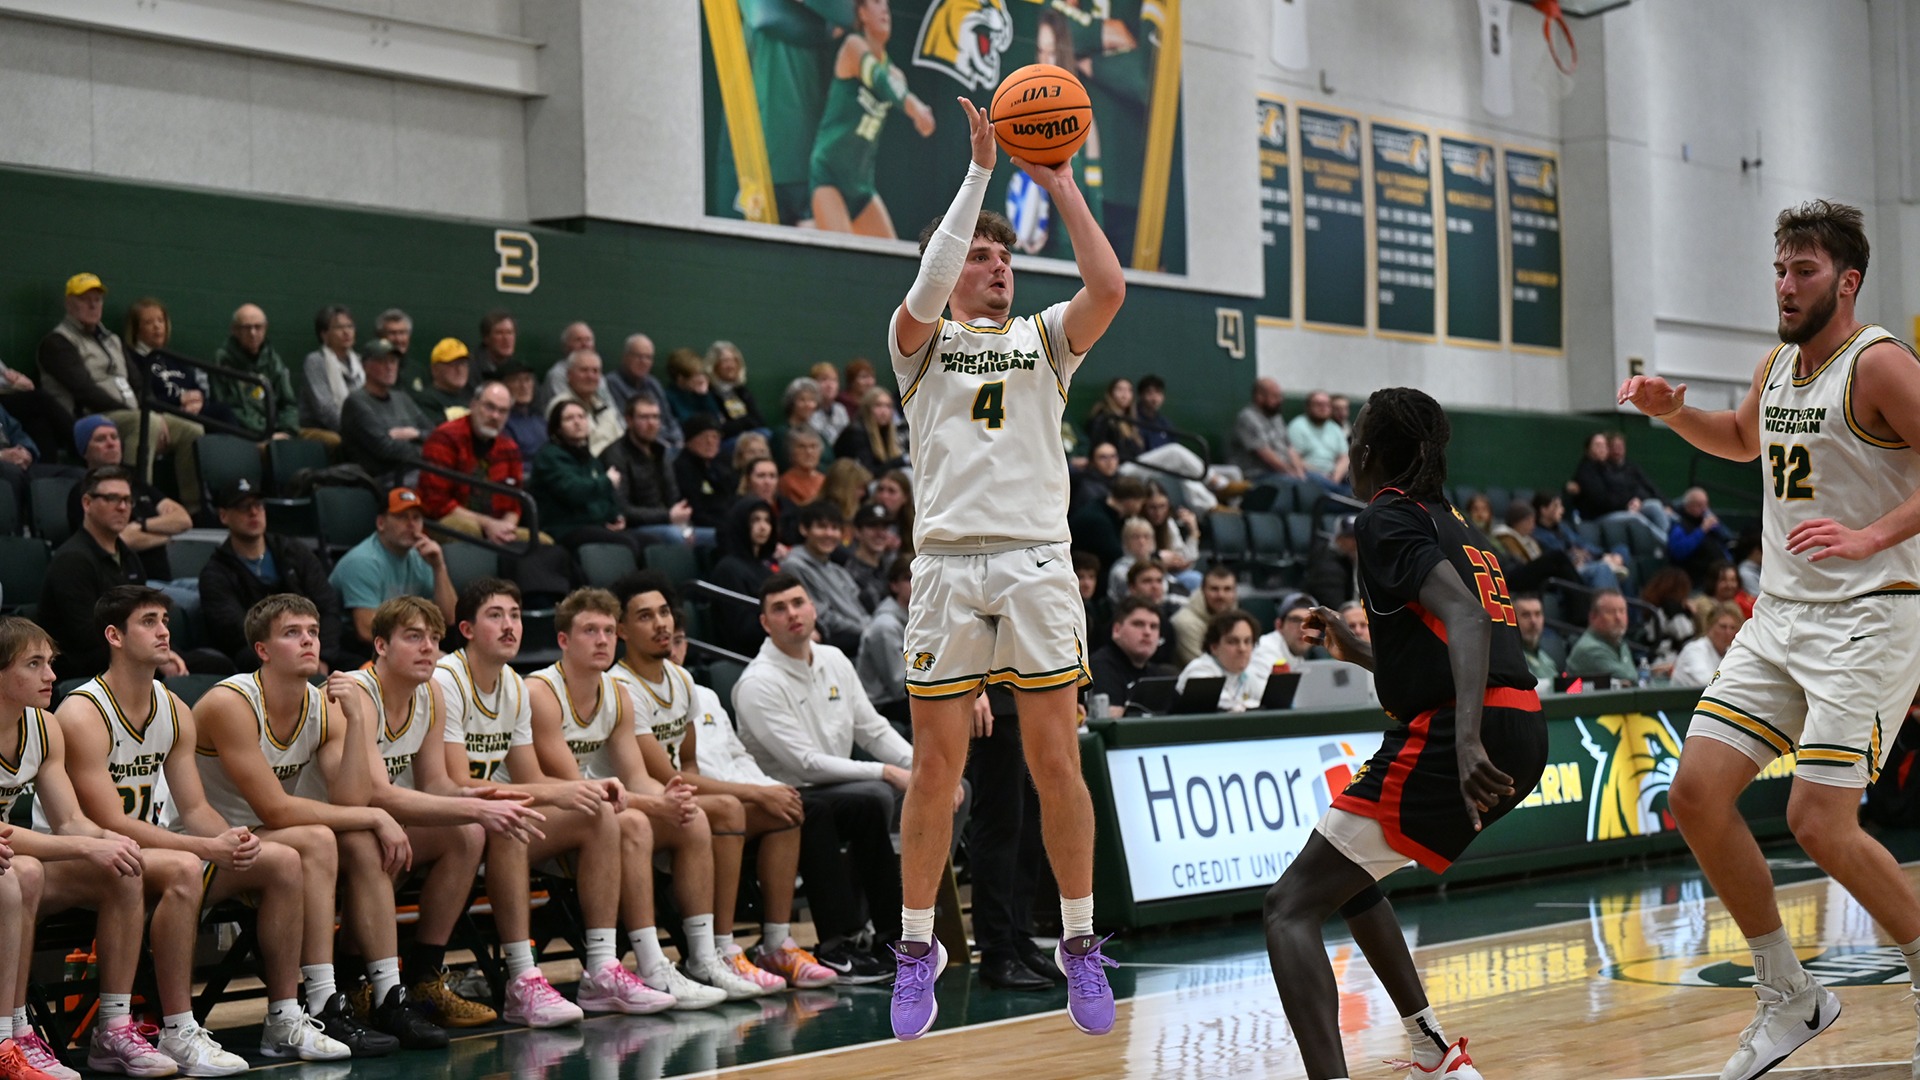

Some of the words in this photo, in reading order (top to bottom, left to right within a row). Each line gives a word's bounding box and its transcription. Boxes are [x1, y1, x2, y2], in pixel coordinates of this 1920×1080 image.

[1022, 85, 1062, 103] EVO
[1011, 115, 1080, 140] Wilson
[495, 229, 540, 294] 3
[1215, 307, 1246, 360] 4
[942, 358, 1036, 375] MICHIGAN
[970, 379, 1007, 431] 4
[1768, 442, 1815, 501] 32
[1137, 754, 1302, 842] Honor
[1171, 857, 1242, 889] CREDIT
[1249, 850, 1300, 879] UNIO
